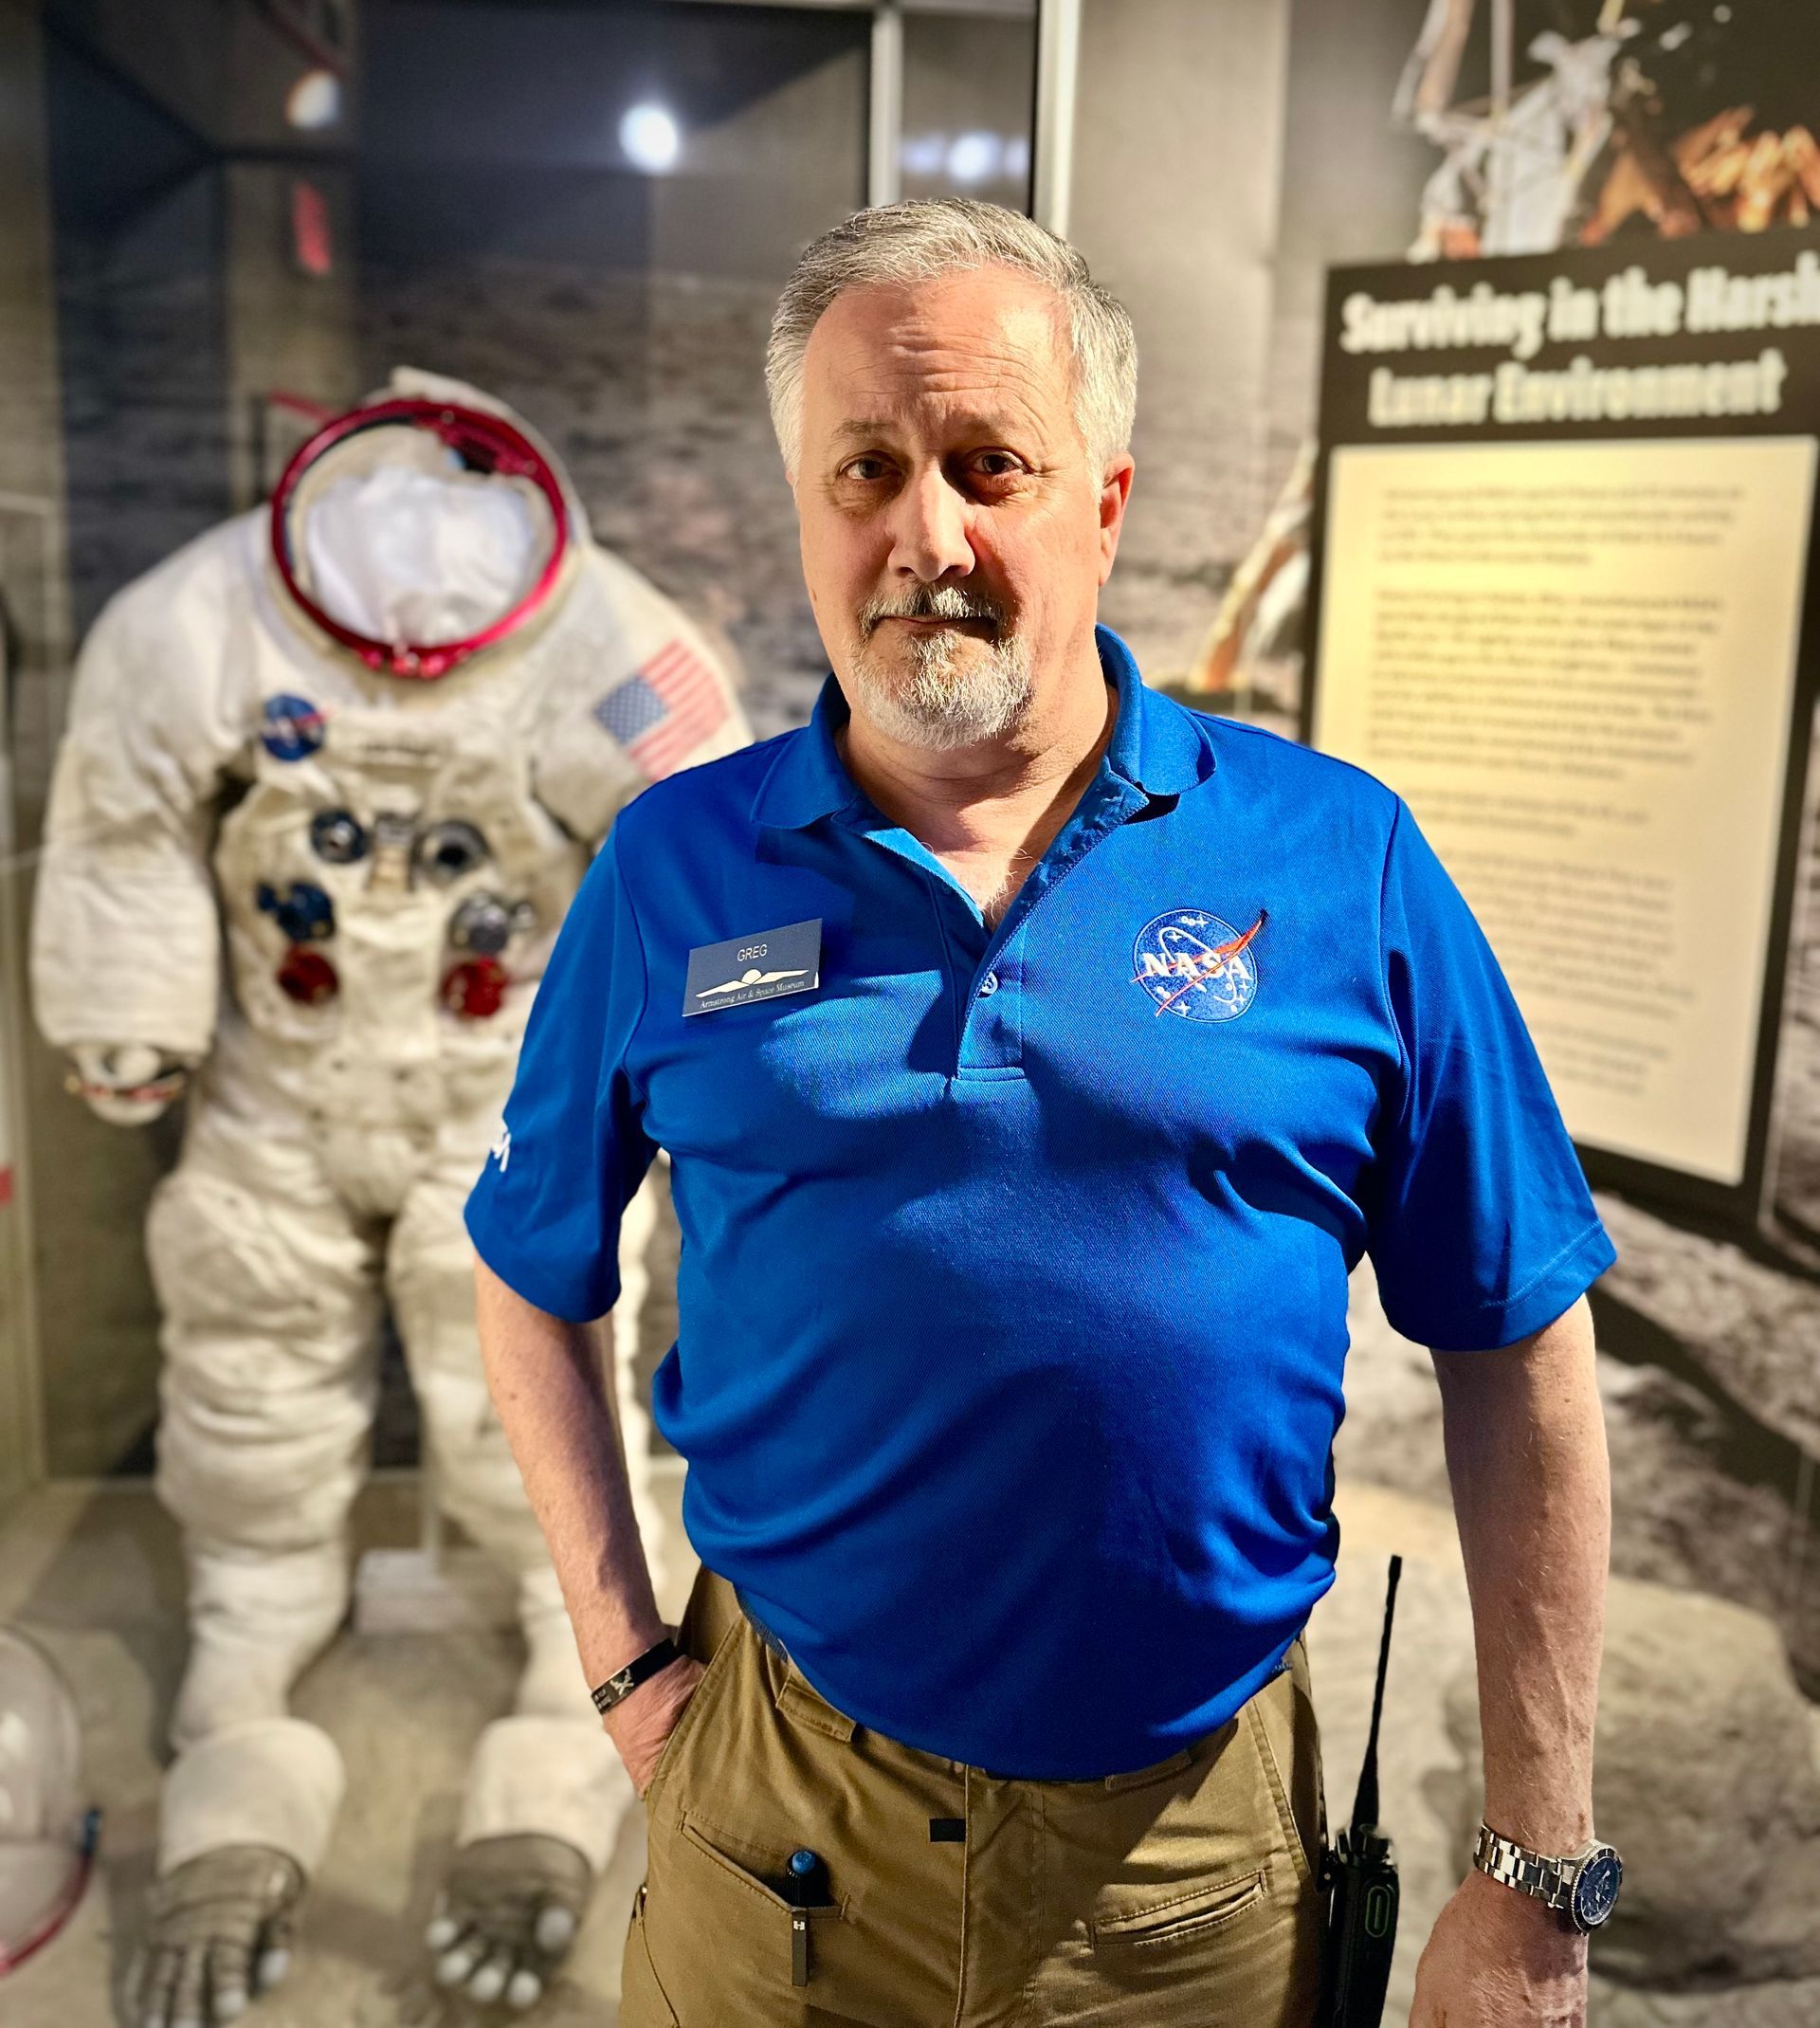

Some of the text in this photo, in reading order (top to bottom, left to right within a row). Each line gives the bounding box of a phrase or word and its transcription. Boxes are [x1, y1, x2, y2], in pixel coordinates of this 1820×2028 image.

[1340, 282, 1546, 358] Surviving
[1547, 277, 1599, 340] in
[1603, 265, 1684, 337] the
[1368, 348, 1786, 427] Lunar Environment
[737, 943, 768, 962] GREG
[1142, 952, 1253, 980] NASA
[700, 980, 805, 1009] Armstrong Air & Space Museum
